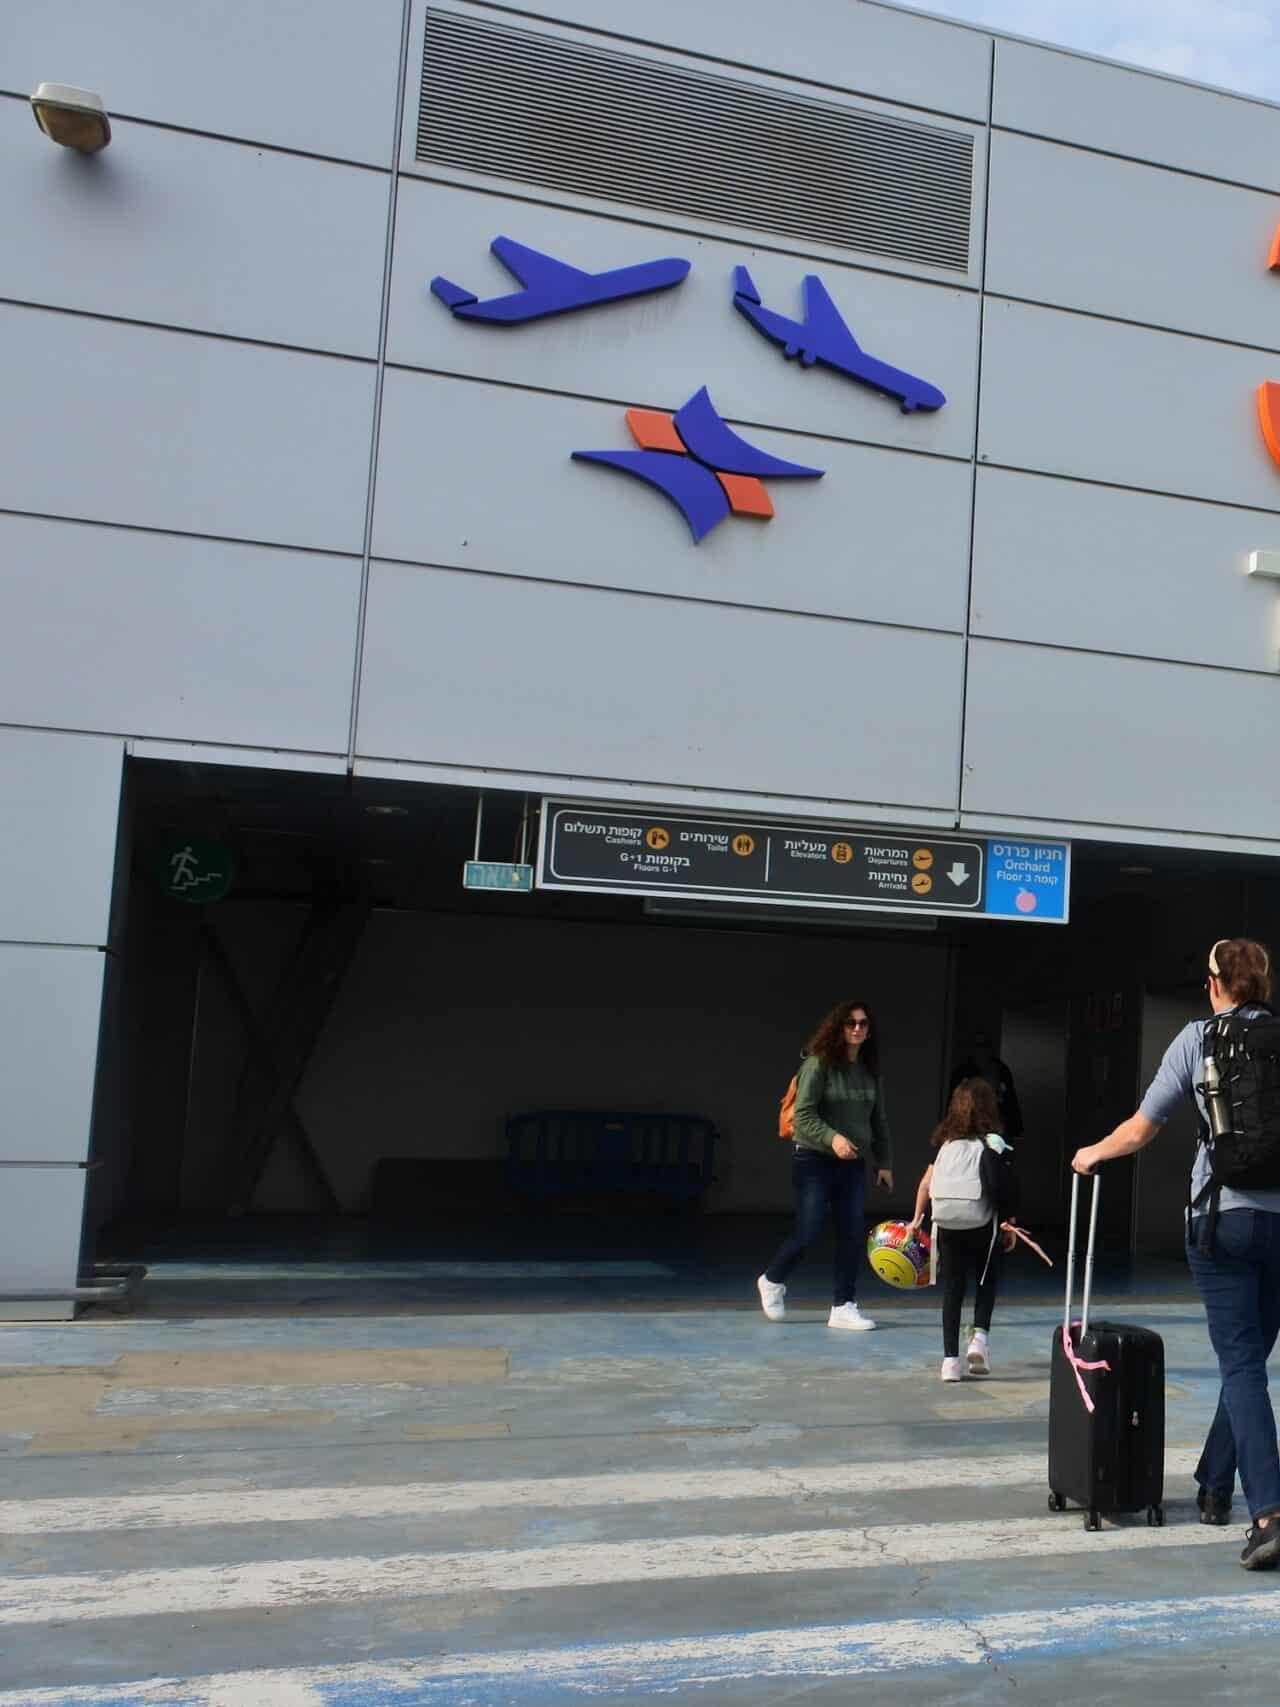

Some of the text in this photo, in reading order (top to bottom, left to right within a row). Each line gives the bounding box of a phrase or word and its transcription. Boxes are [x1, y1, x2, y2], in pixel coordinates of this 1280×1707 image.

[563, 821, 643, 839] קופות תשלום
[680, 831, 729, 844] שירותים
[784, 839, 828, 852] מעליות
[863, 846, 909, 859] המראות
[1034, 847, 1062, 861] חניון
[1004, 858, 1051, 873] Orchard
[868, 870, 908, 883] נחיתות
